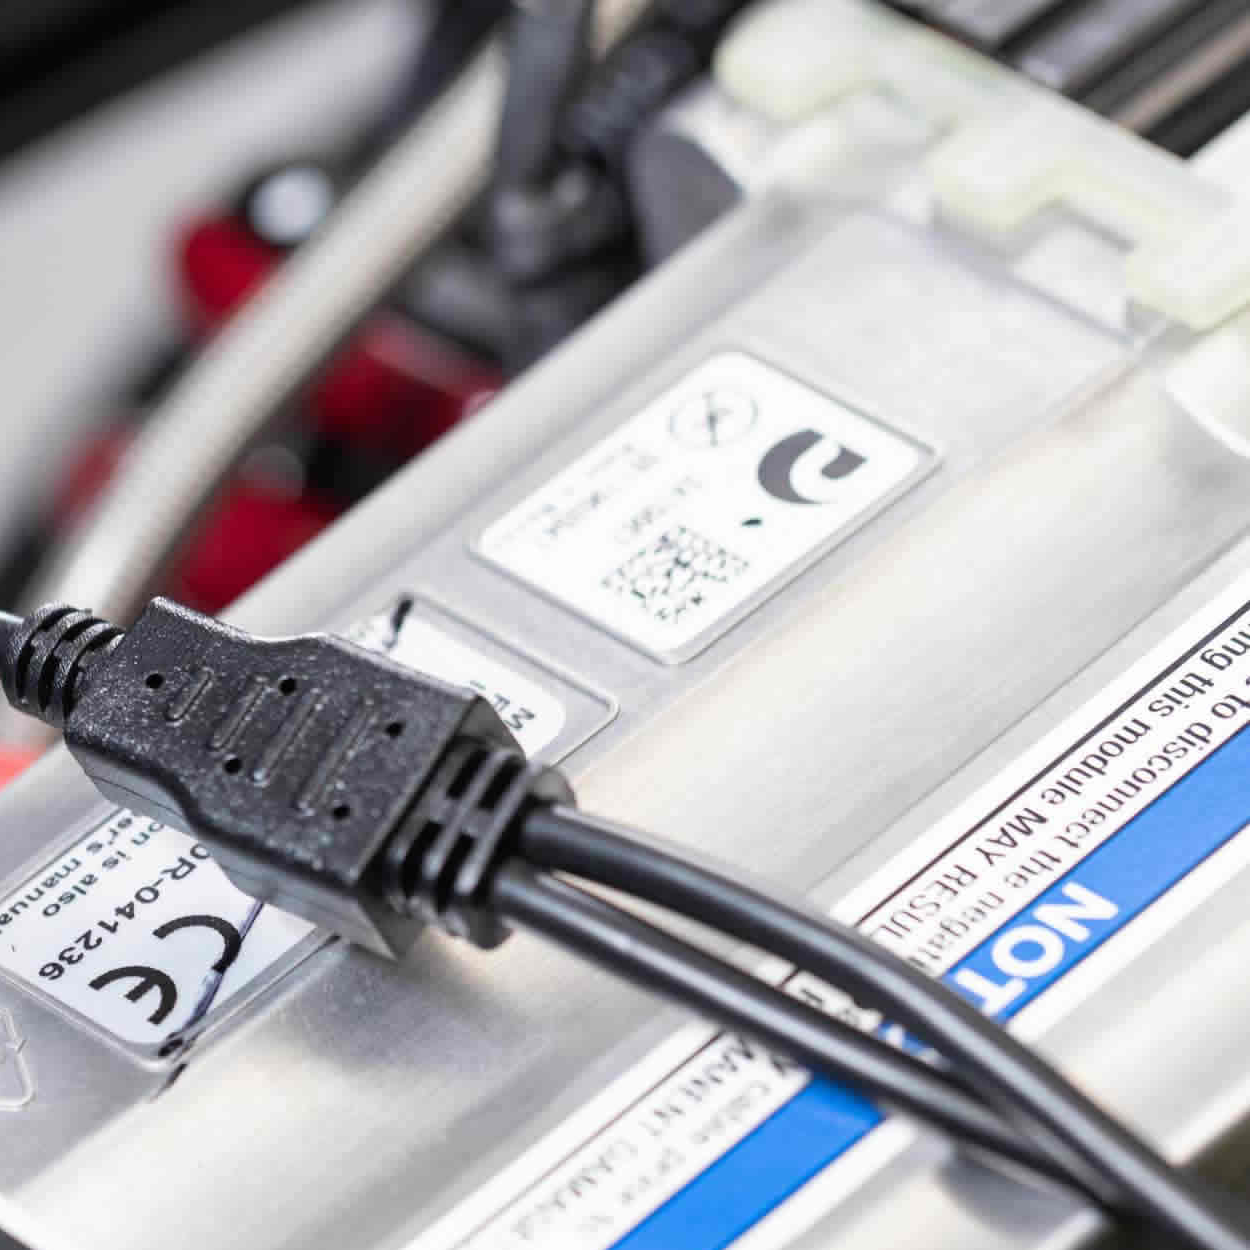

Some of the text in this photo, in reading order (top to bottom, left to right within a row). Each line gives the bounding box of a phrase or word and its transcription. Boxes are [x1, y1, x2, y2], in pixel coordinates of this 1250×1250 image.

[1148, 672, 1214, 717] this
[1040, 718, 1152, 806] module
[1055, 722, 1213, 852] disconnect
[101, 849, 129, 870] is
[975, 806, 1049, 868] MAY
[41, 873, 99, 918] also
[1004, 848, 1062, 889] the
[868, 864, 980, 938] RESUL
[89, 914, 242, 1026] CE
